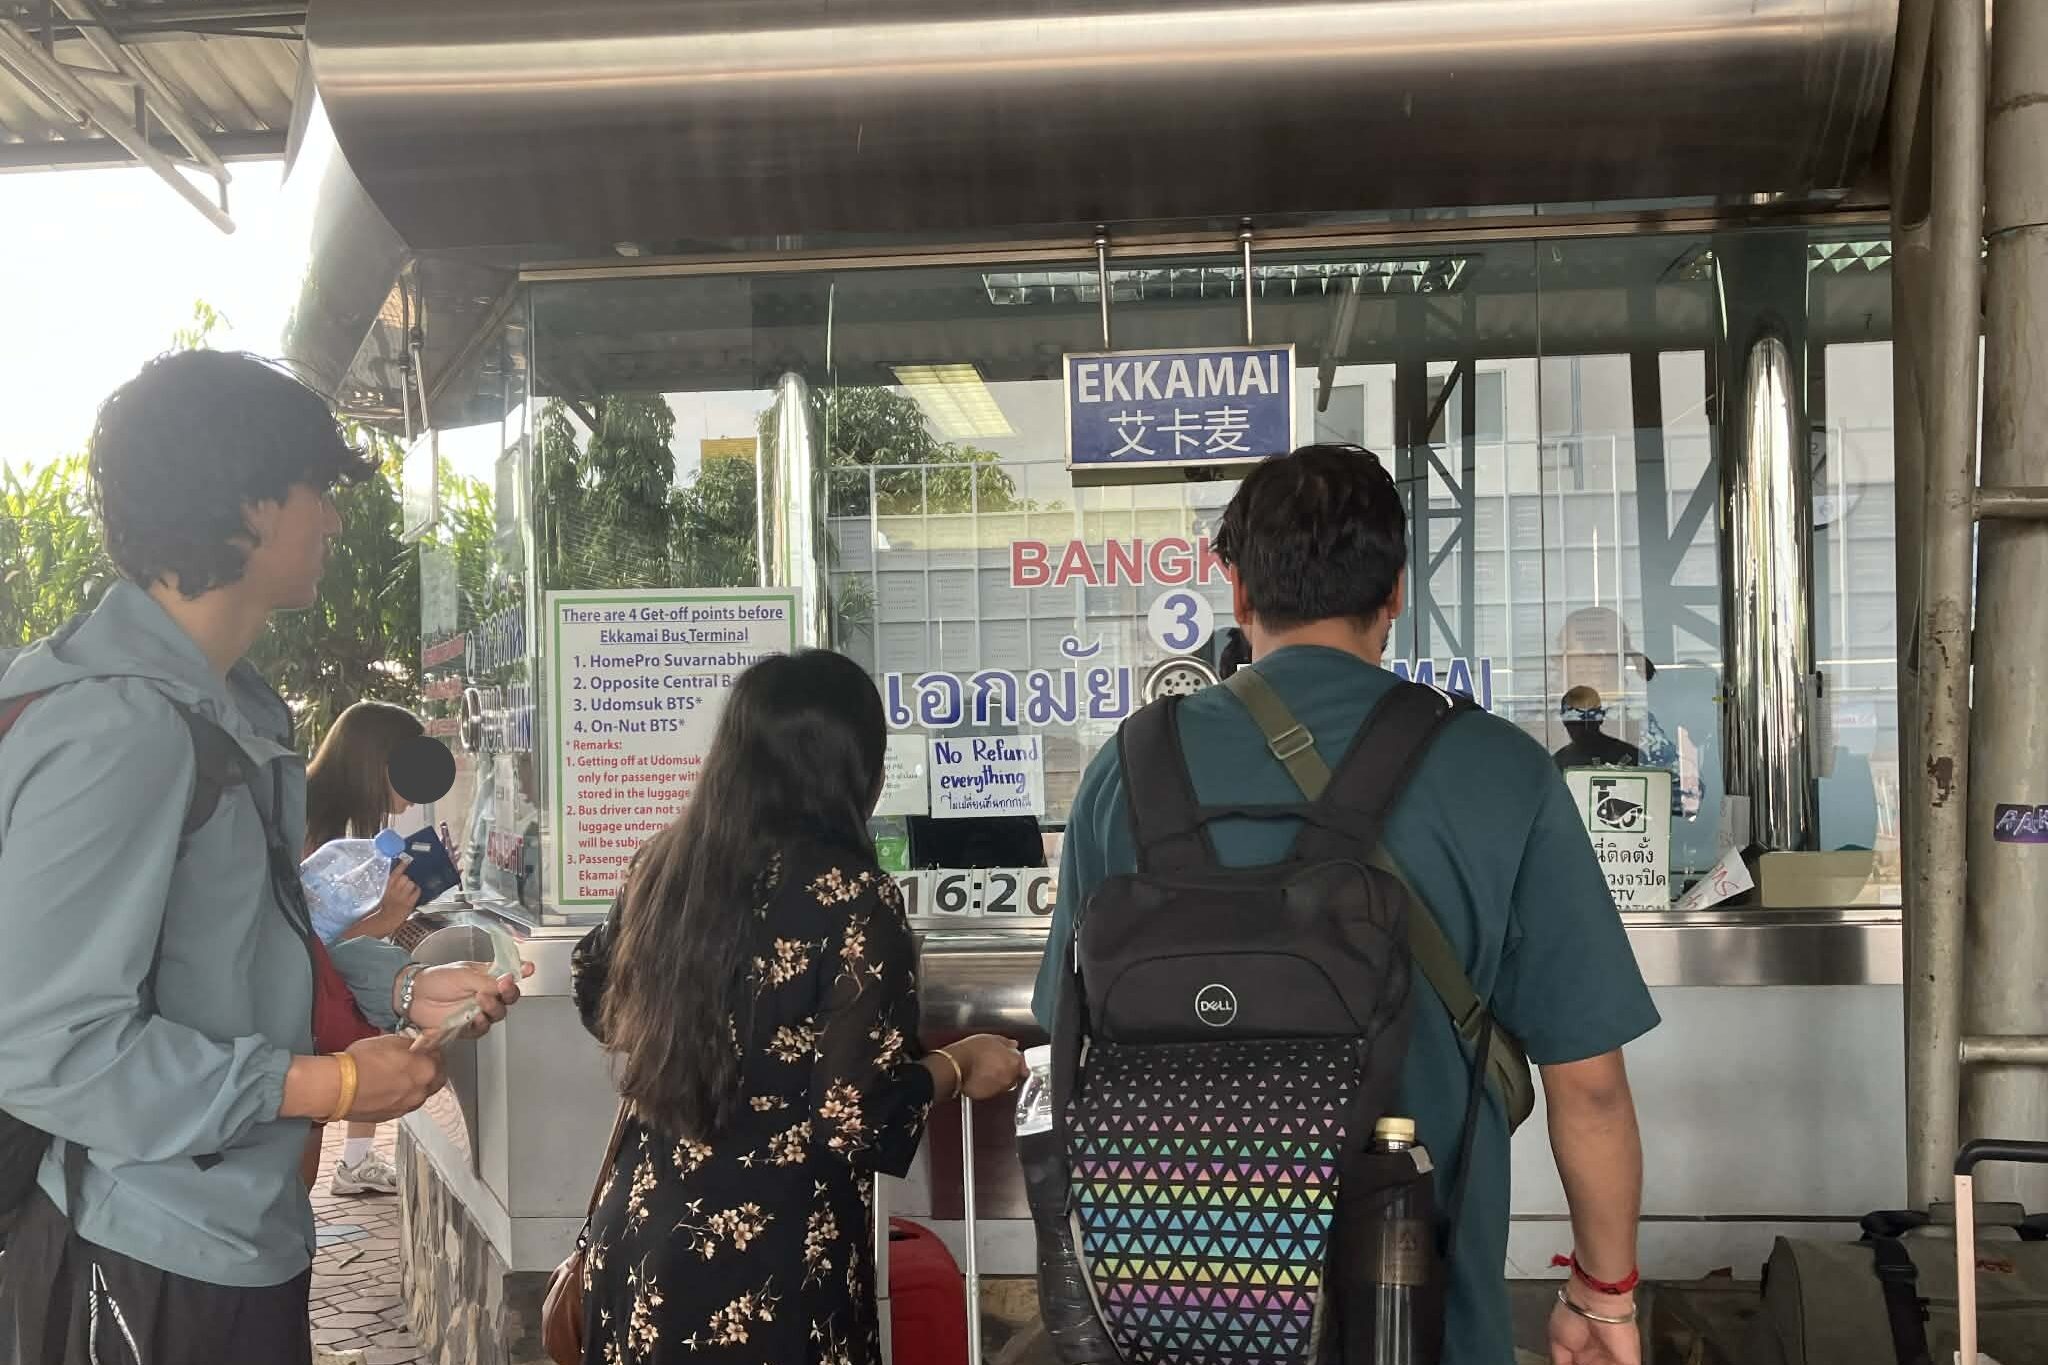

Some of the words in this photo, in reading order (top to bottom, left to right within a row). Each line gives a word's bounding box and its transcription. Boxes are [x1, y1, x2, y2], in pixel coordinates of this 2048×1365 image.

[1077, 354, 1279, 403] EKKAMAI
[1108, 405, 1251, 458] 艾卡麦
[562, 608, 601, 622] There
[604, 610, 626, 621] are
[629, 608, 637, 620] 4
[640, 606, 688, 620] Get-off
[692, 606, 735, 623] points
[738, 604, 784, 619] before
[1162, 594, 1200, 650] 3
[600, 628, 659, 643] Ekkamai
[662, 628, 686, 643] Bus
[688, 626, 749, 641] Terminal
[573, 656, 587, 668] 1.
[590, 654, 660, 668] HomePro
[573, 677, 587, 690] 2.
[590, 676, 660, 692] Opposite
[664, 674, 718, 689] Central
[884, 634, 1133, 728] เอกมัย
[574, 699, 587, 712] 3.
[591, 697, 663, 711] Udomsuk
[574, 720, 587, 733] 4.
[591, 719, 646, 733] On-Nut
[573, 740, 622, 750] Remarks:
[934, 741, 963, 765] No
[972, 737, 1038, 762] Refund
[566, 757, 575, 767] 1.
[578, 756, 618, 768] Getting
[620, 755, 636, 766] off
[637, 756, 649, 766] at
[650, 755, 702, 766] Udomsuk
[578, 773, 601, 785] only
[604, 772, 619, 782] for
[621, 772, 676, 786] passenger
[940, 765, 1026, 793] everything
[578, 788, 612, 799] stored
[614, 789, 624, 798] in
[627, 788, 646, 798] the
[567, 806, 576, 816] 2.
[579, 805, 597, 815] Bus
[600, 804, 631, 815] driver
[634, 806, 653, 815] can
[655, 805, 673, 814] not
[578, 820, 622, 834] luggage
[579, 838, 597, 848] will
[600, 837, 613, 848] be
[567, 855, 576, 865] 3.
[579, 870, 618, 880] Ekamai
[1200, 1000, 1232, 1011] DELL
